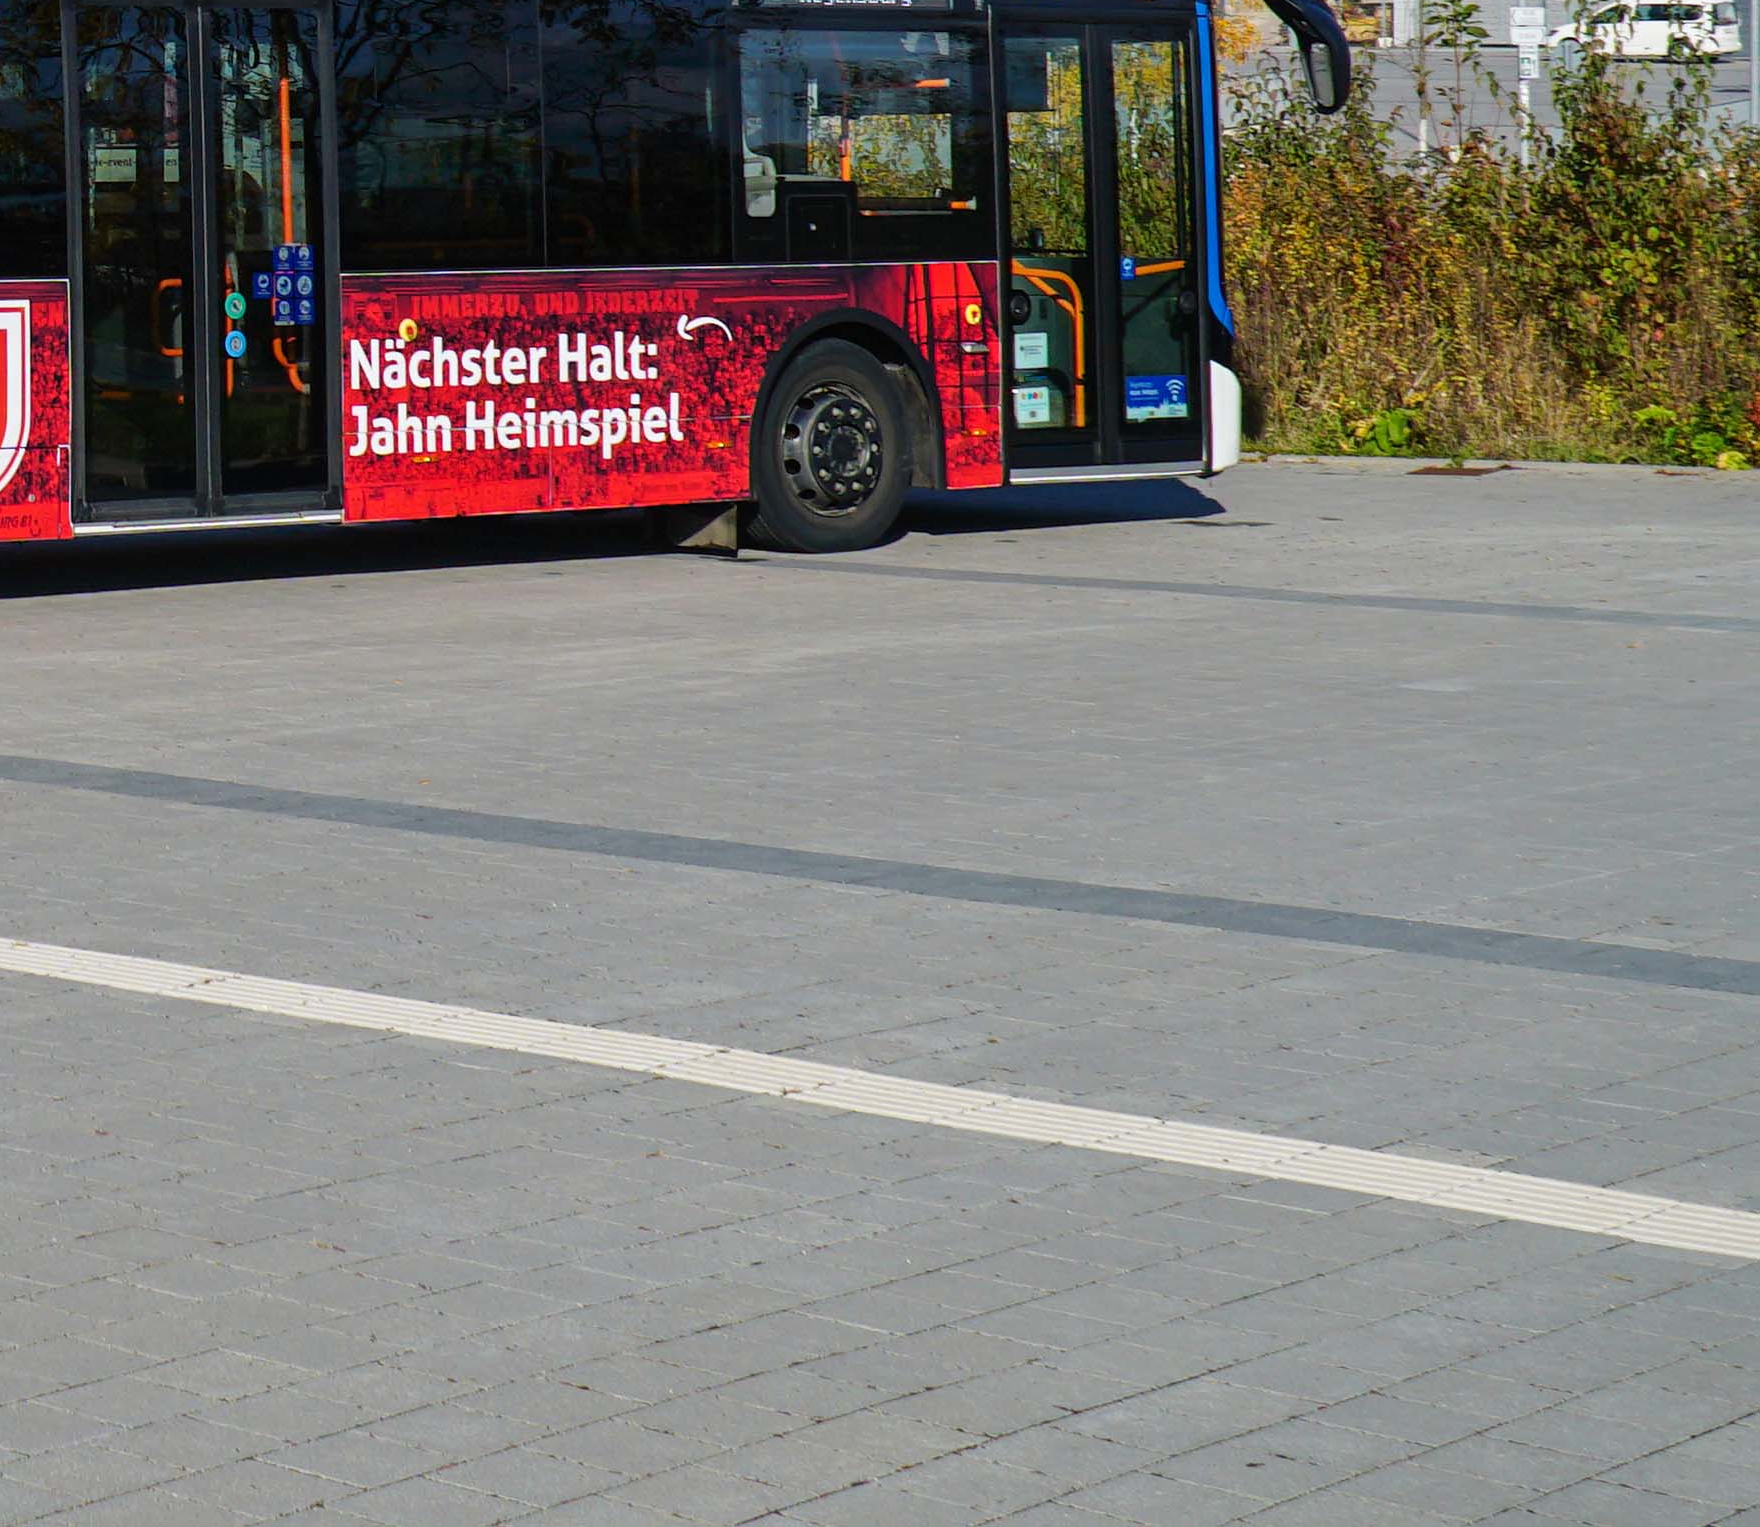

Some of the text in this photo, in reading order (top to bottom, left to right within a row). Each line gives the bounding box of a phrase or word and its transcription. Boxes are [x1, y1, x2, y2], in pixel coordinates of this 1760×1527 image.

[349, 331, 659, 390] Nächster Halt:
[349, 392, 685, 460] Jahn Heimspiel
